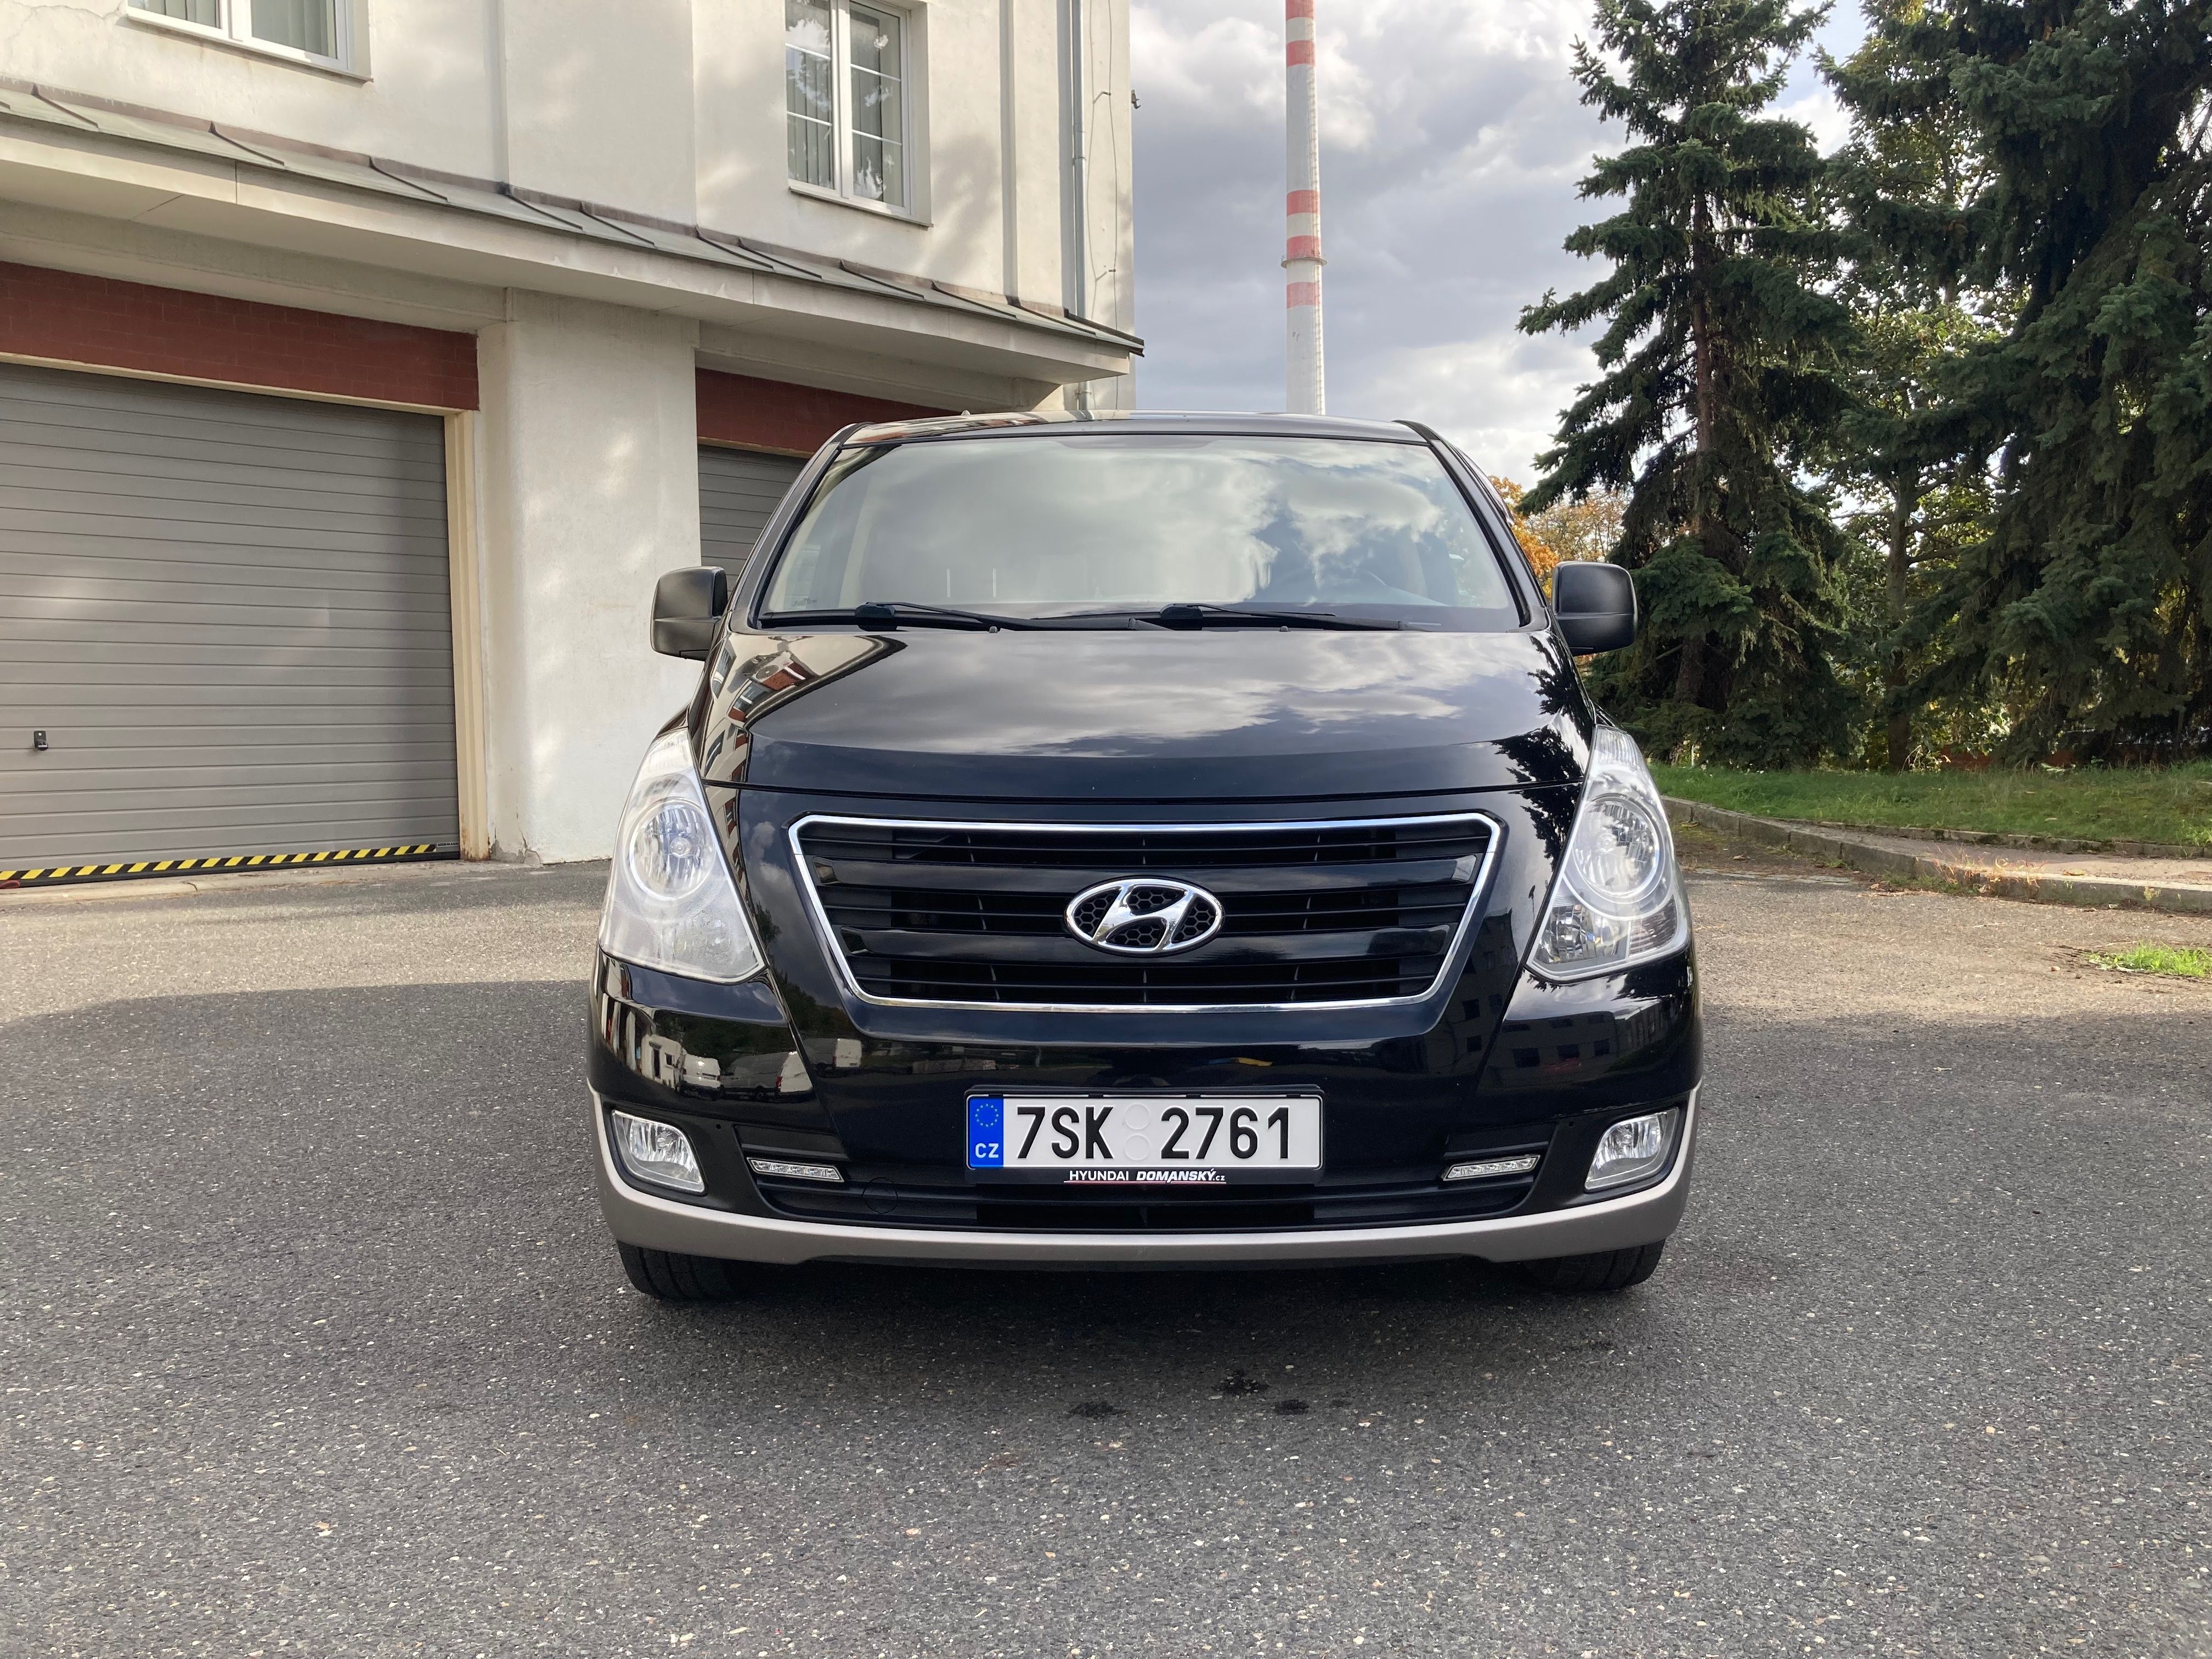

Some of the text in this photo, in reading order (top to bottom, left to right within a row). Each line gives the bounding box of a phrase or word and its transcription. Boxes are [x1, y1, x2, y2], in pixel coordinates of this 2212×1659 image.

[1017, 1106, 1289, 1159] 7SK 2761
[975, 1143, 999, 1158] CZ
[1069, 1170, 1129, 1181] HYUNDAI
